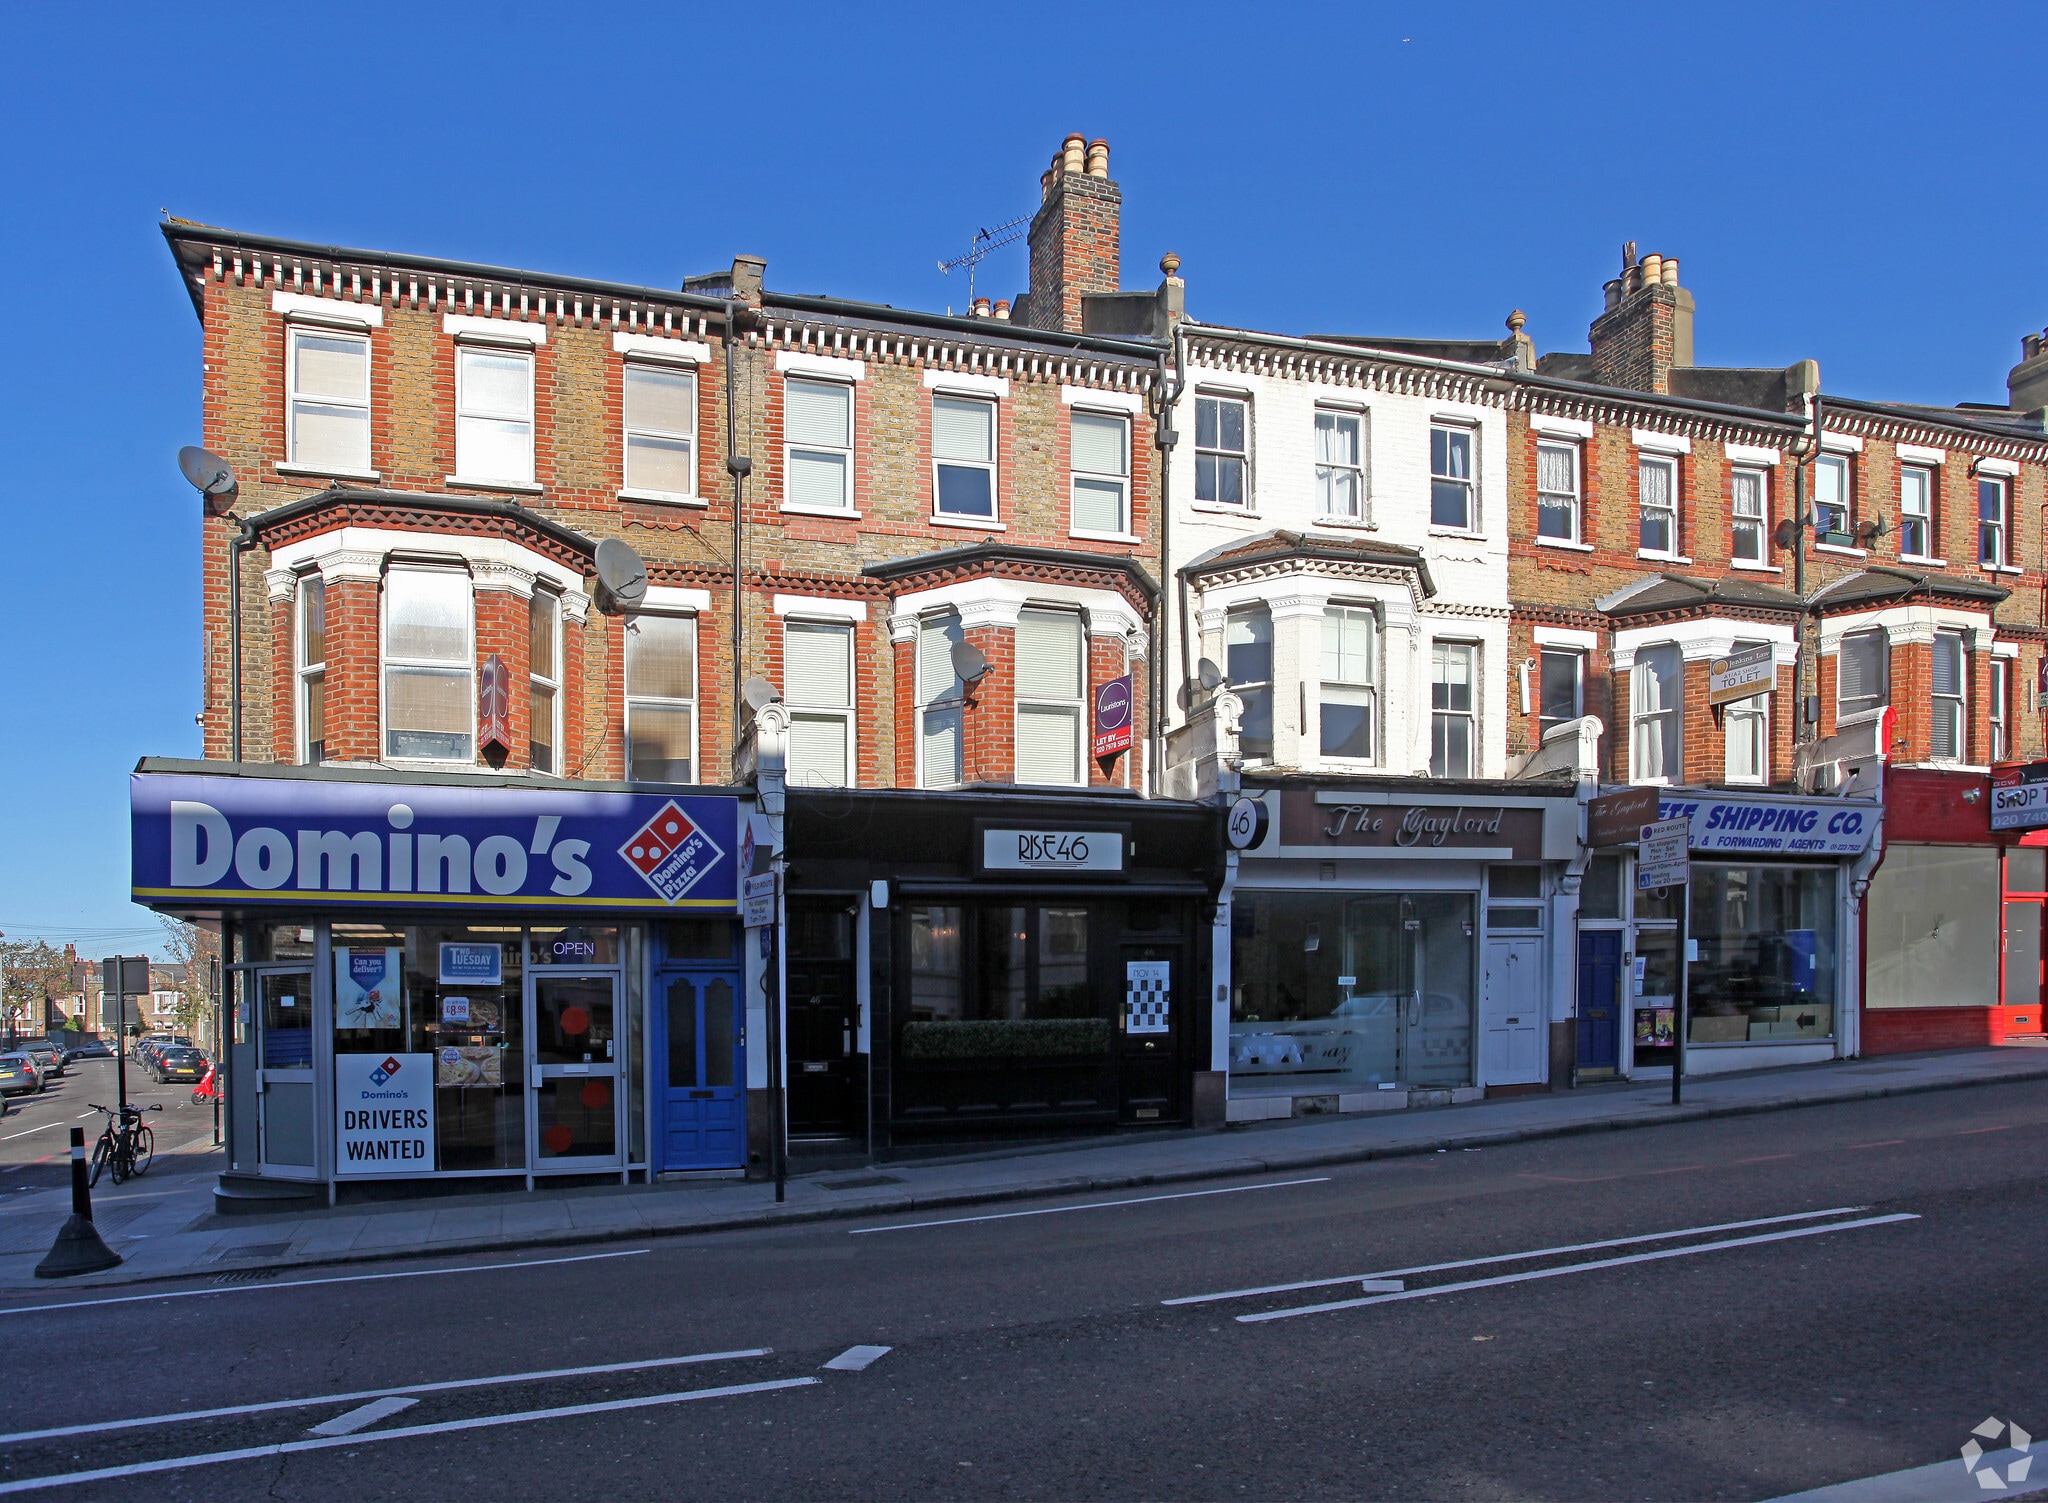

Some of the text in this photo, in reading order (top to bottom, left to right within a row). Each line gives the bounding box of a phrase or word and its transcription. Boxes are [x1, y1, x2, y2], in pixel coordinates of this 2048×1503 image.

[1729, 656, 1753, 668] Jenkins
[1742, 666, 1758, 674] SHOP
[1721, 671, 1760, 688] TO LET
[1100, 699, 1126, 712] Lauristons
[1096, 736, 1107, 746] LET
[1590, 798, 1649, 817] The Gaylord
[1231, 811, 1249, 836] 46
[1324, 805, 1504, 847] The Gaylord
[1705, 805, 1819, 833] SHIPPING
[1828, 812, 1863, 835] CO.
[1993, 814, 2018, 826] 020
[1666, 823, 1686, 831] ROUTE
[171, 800, 593, 897] Domino's
[1656, 839, 1679, 848] stopping
[1701, 836, 1709, 846] &
[1717, 836, 1782, 848] FORWARDING
[1788, 838, 1826, 850] AGENTS
[652, 838, 703, 886] Domino's
[662, 866, 697, 897] Pizza
[553, 942, 594, 954] OPEN
[354, 958, 367, 966] Can
[1134, 969, 1149, 978] NOV
[446, 1005, 466, 1016] £8.99
[362, 1090, 408, 1099] Domino's
[344, 1109, 428, 1130] DRIVERS
[346, 1140, 425, 1160] WANTED
